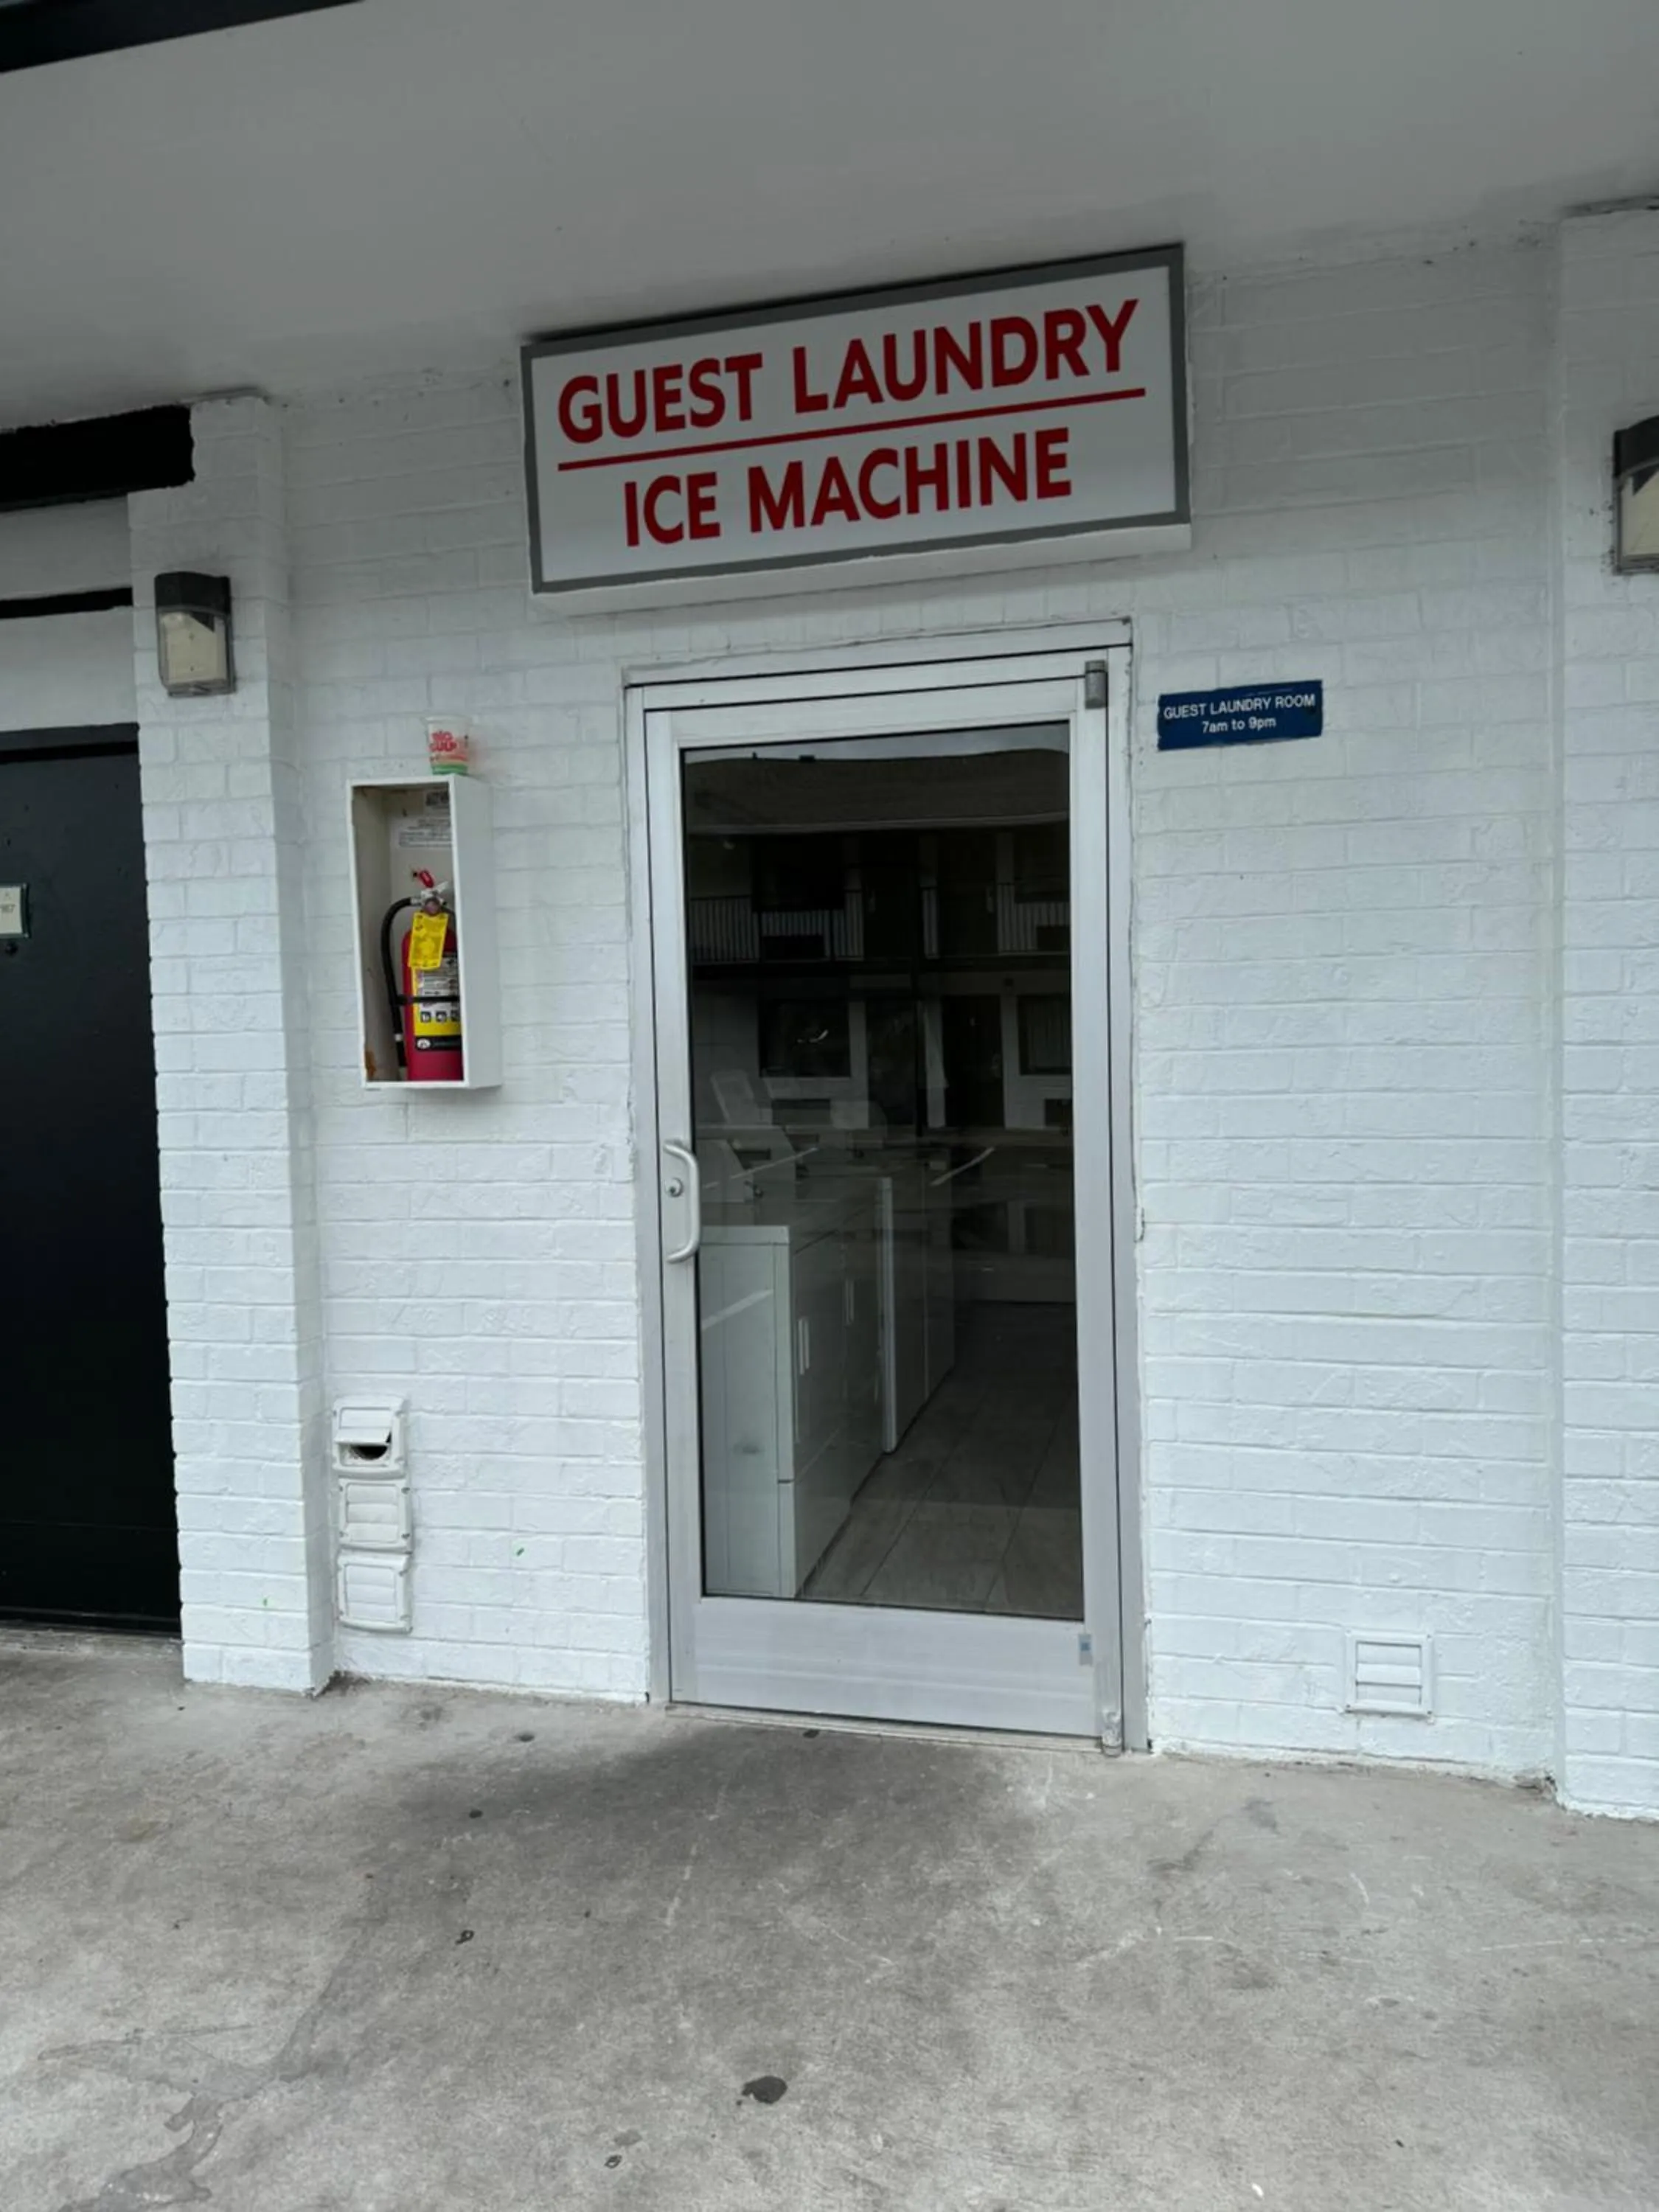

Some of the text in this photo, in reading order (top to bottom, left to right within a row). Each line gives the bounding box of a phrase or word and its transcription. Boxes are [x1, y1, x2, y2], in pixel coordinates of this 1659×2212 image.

[559, 299, 1139, 442] GUEST LAUNDRY
[625, 428, 1072, 546] ICE MACHINE
[1164, 694, 1315, 720] GUEST LAUNDRY ROOM
[1202, 716, 1276, 733] 7am to 9pm
